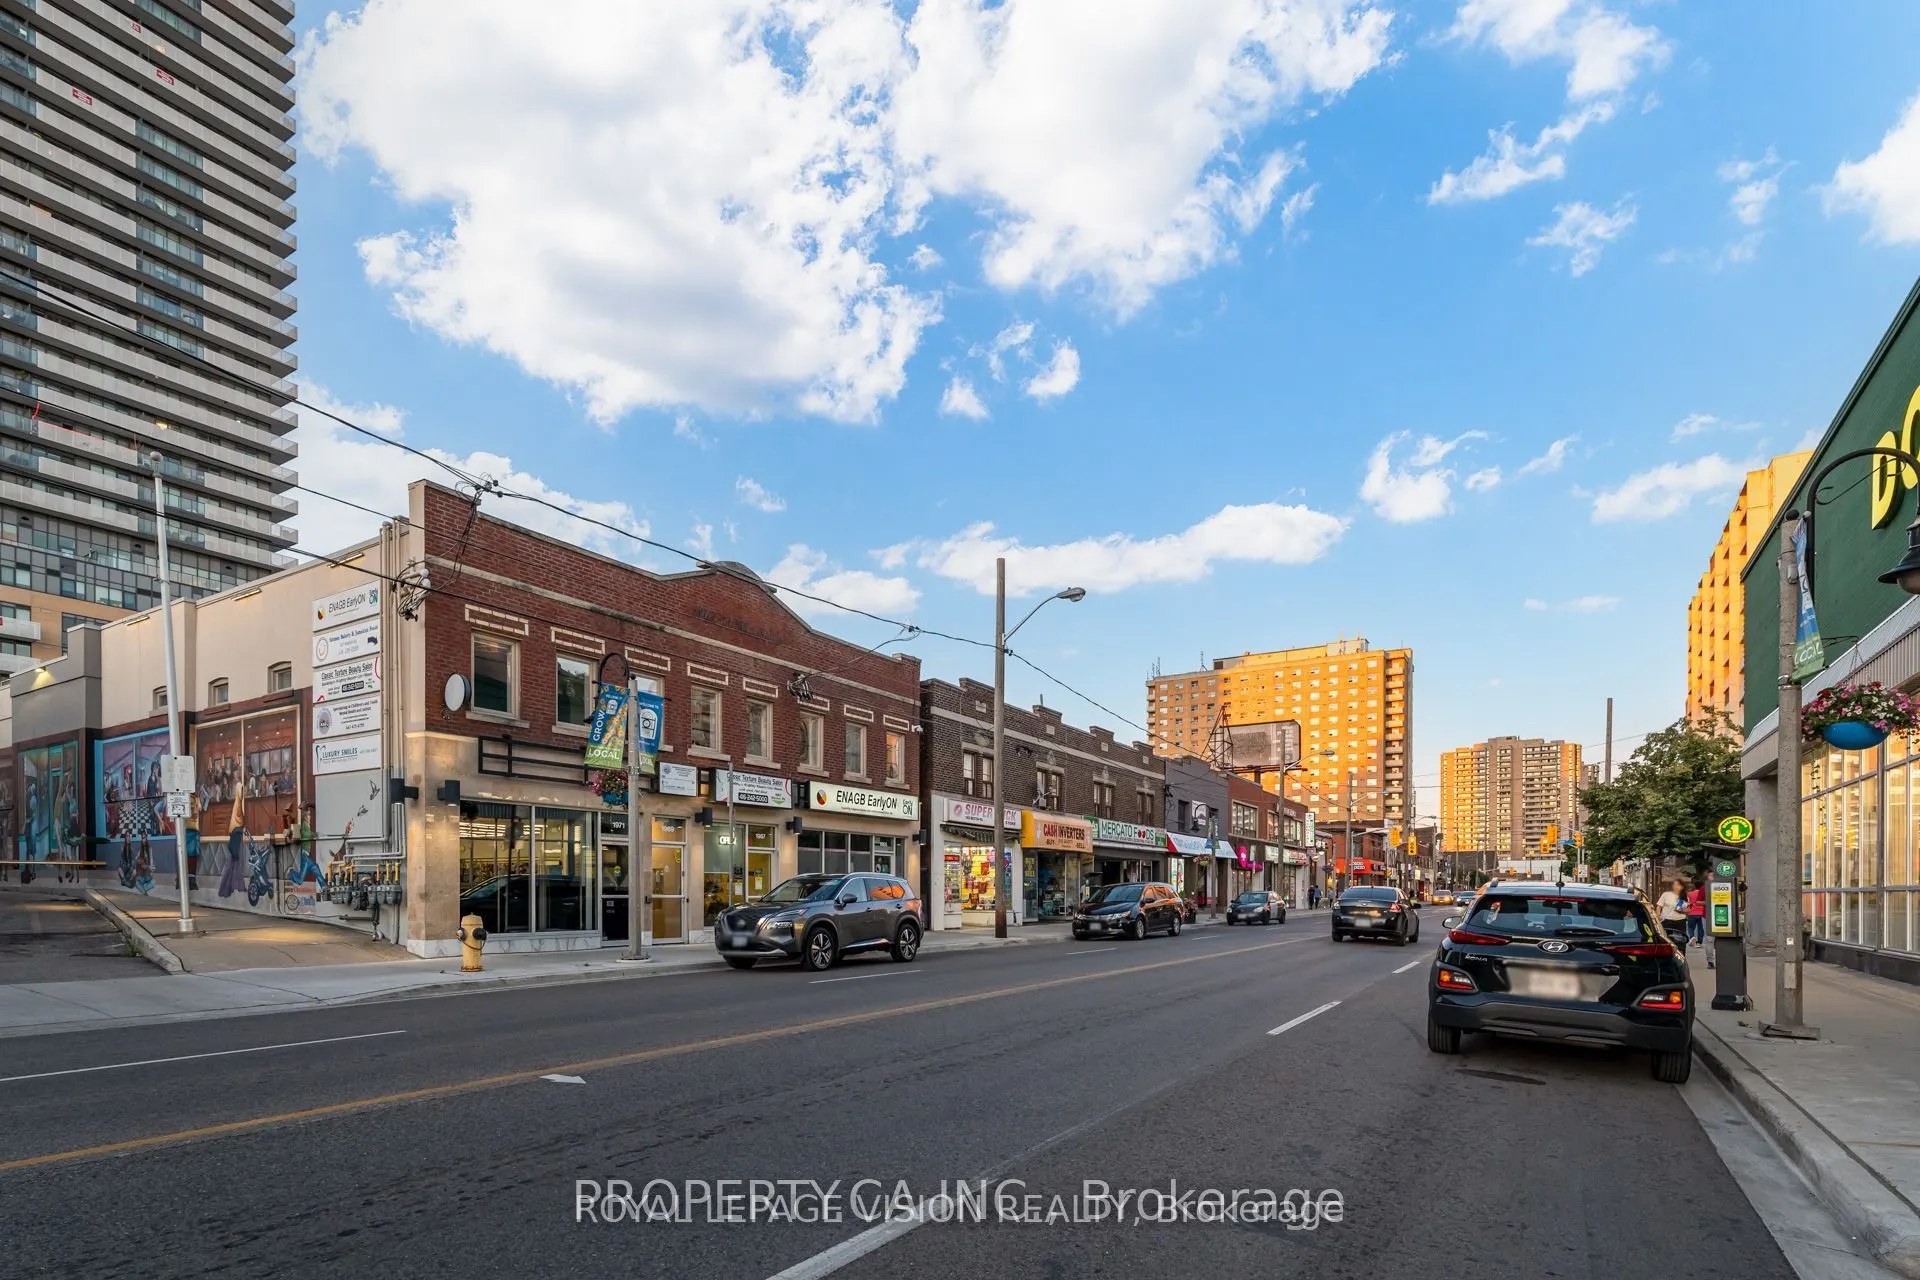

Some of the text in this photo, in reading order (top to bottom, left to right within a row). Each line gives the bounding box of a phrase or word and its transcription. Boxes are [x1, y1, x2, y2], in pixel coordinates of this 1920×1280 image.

[593, 710, 606, 742] GROW
[322, 751, 341, 759] LUXURY
[588, 748, 620, 760] LOCAL
[836, 790, 898, 811] ENAGB EarlyON
[902, 804, 914, 816] ON
[964, 804, 993, 819] SUPER
[1043, 823, 1058, 838] CASH
[1101, 820, 1133, 838] MERCATO
